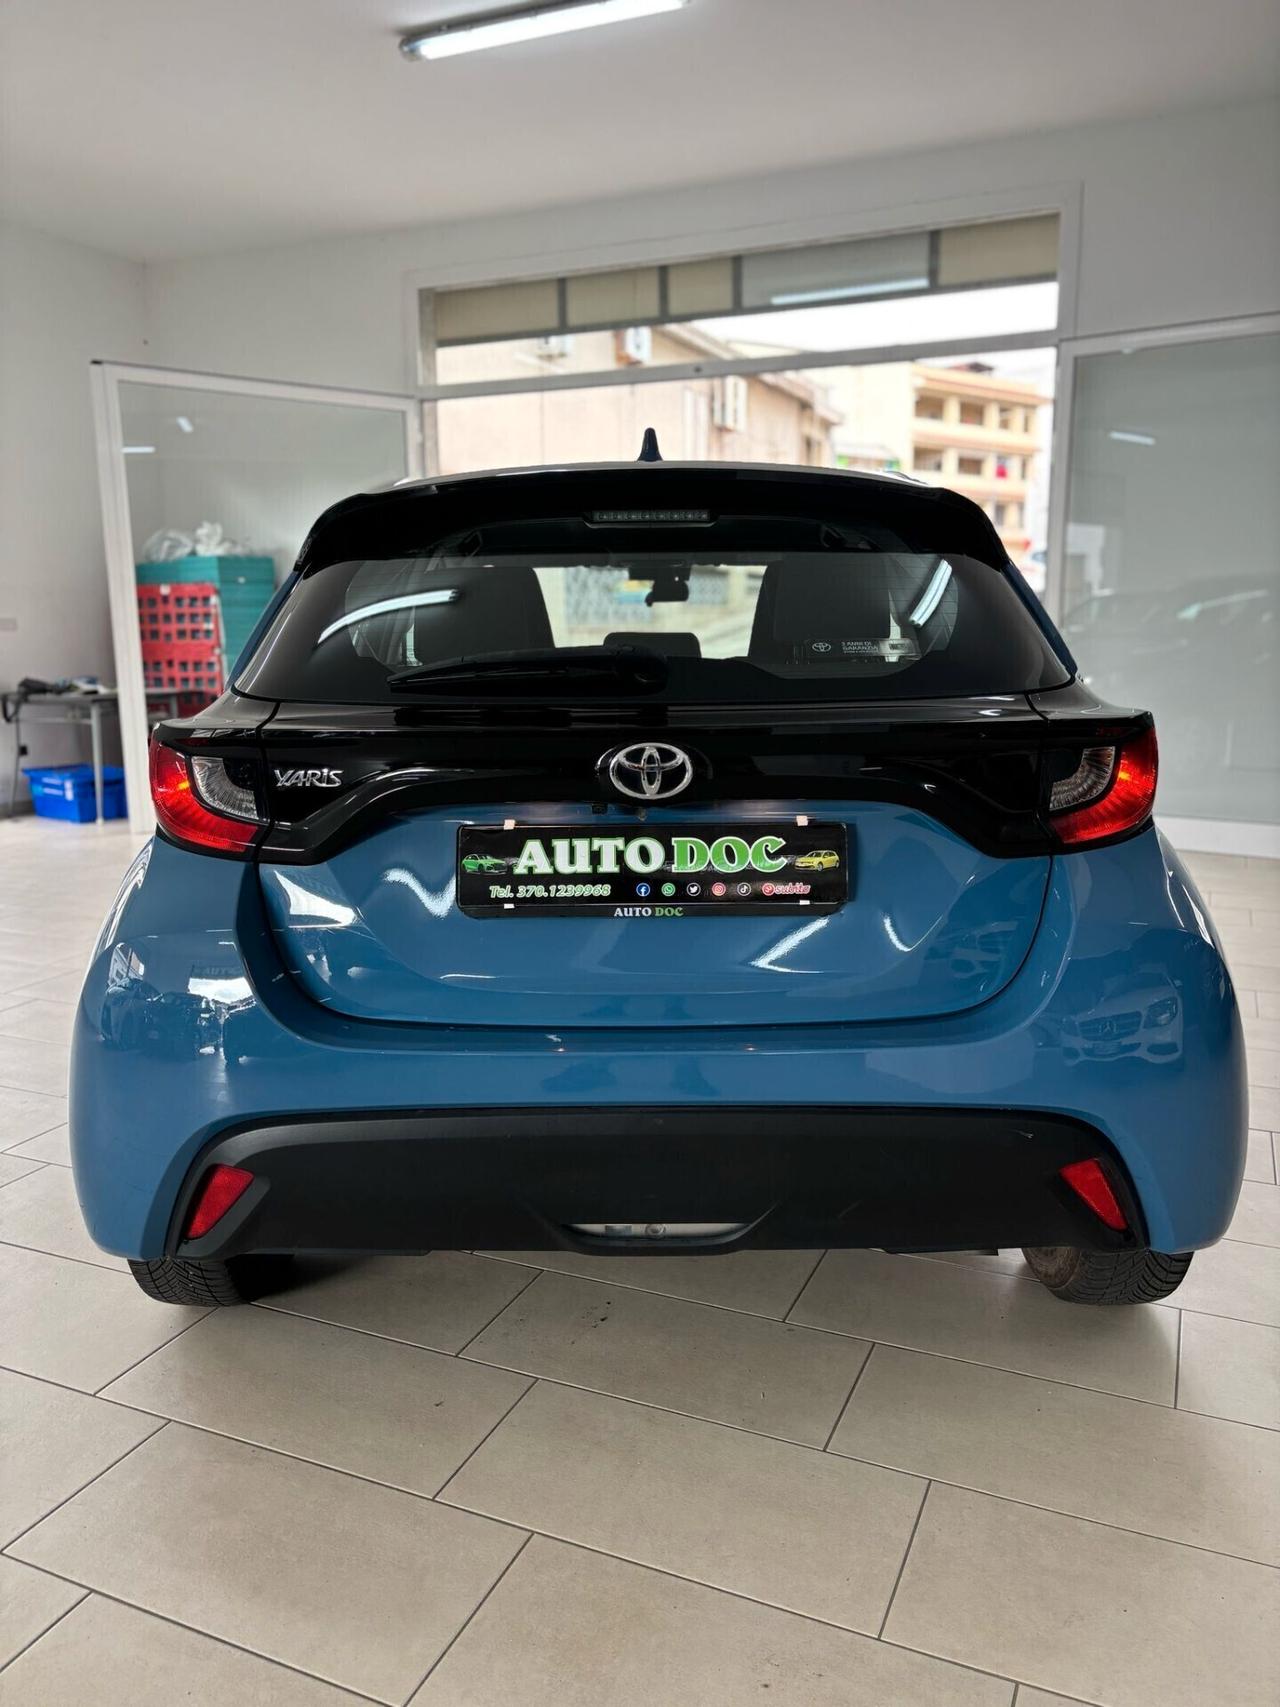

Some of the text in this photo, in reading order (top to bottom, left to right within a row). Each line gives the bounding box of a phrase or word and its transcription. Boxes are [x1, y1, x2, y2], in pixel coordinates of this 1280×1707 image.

[513, 835, 788, 875] AUTO DOC
[489, 884, 612, 898] Tel. 370.1239968
[614, 906, 684, 917] AUTO DOC
